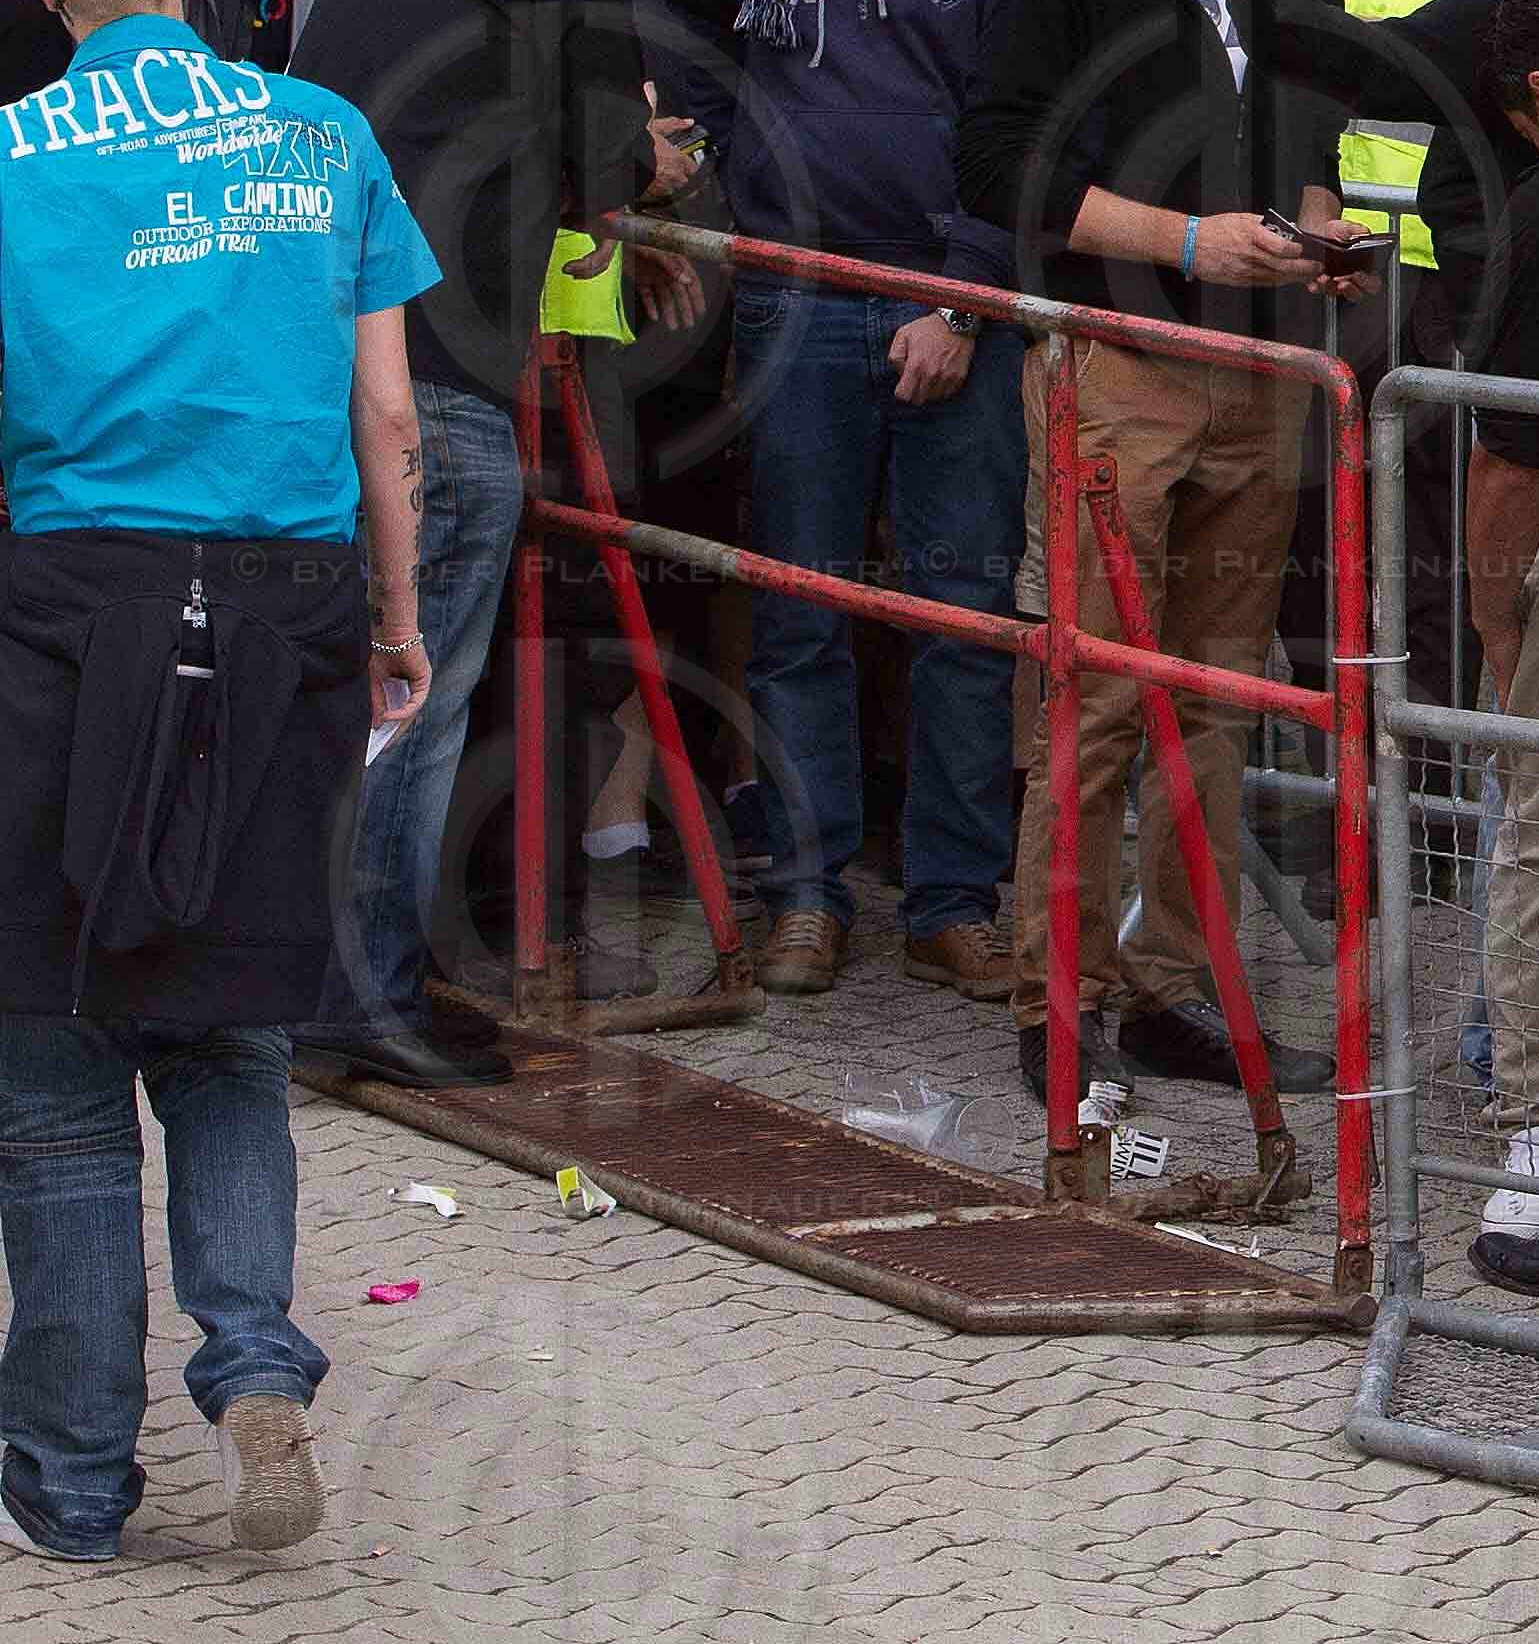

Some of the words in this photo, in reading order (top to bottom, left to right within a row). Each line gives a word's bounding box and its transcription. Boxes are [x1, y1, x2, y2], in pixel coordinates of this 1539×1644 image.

[0, 49, 272, 159] TRACKS
[166, 191, 208, 226] EL
[223, 182, 333, 218] CAMINO
[125, 235, 211, 270] OFFROAD
[132, 221, 215, 246] OUTDOOR
